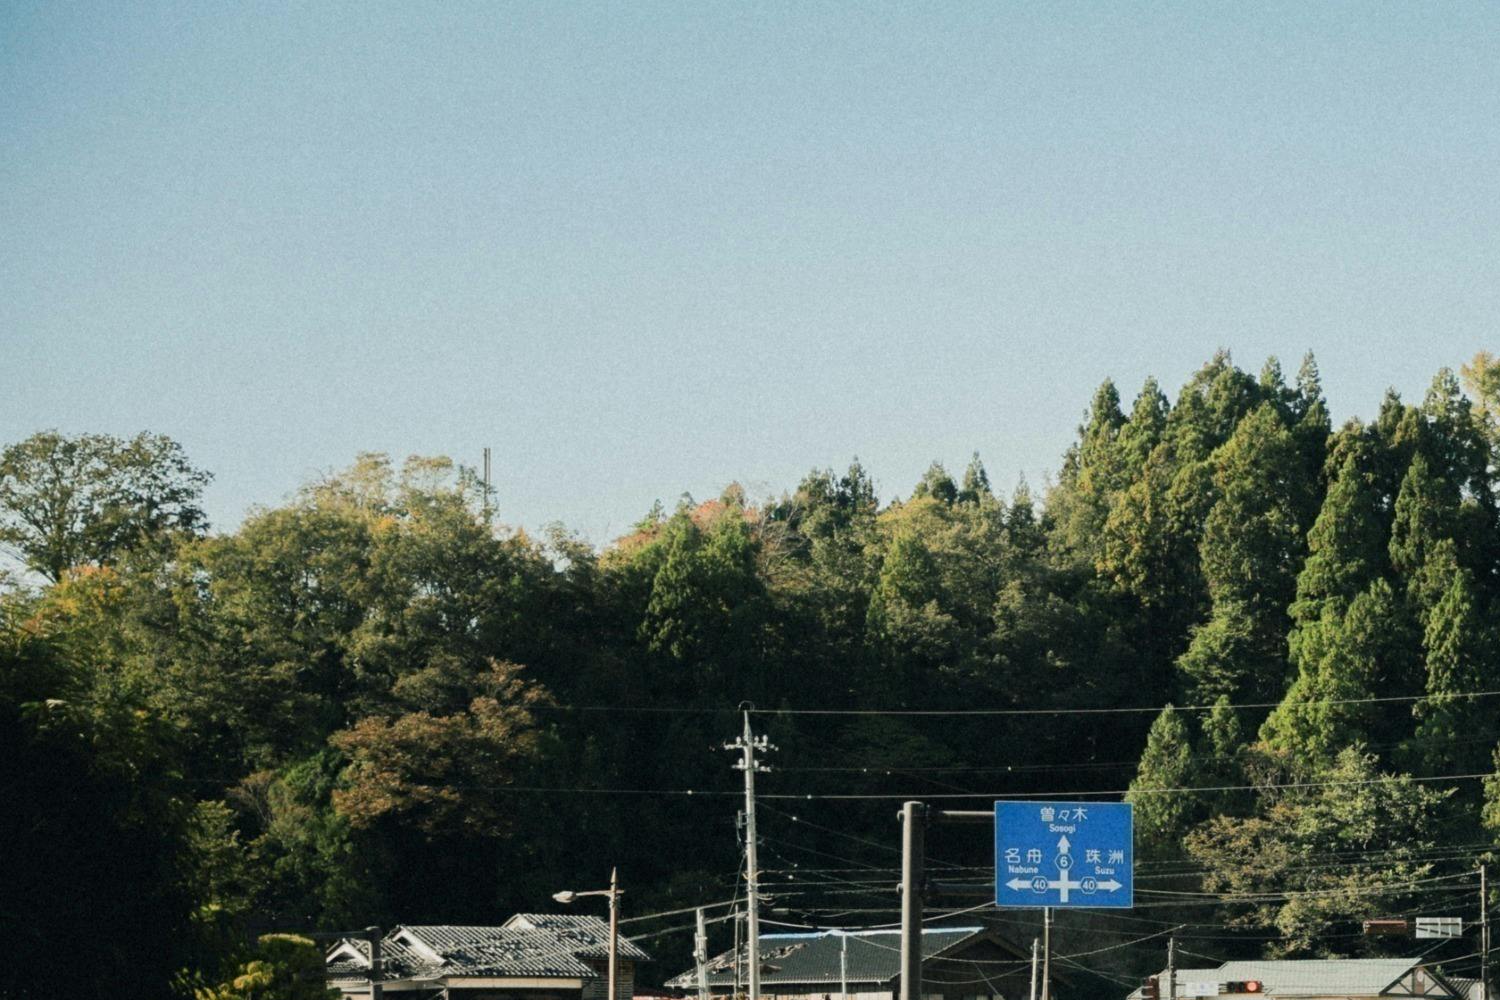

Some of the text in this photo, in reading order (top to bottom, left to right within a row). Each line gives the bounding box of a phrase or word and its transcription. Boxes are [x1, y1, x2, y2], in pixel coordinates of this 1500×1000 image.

[1049, 823, 1076, 834] Sosogi
[1004, 847, 1043, 864] 名舟
[1085, 849, 1124, 865] 珠洲
[1060, 857, 1068, 867] 6
[1008, 865, 1039, 874] Nabune
[1095, 866, 1115, 875] Suzu
[1033, 881, 1046, 890] 40
[1082, 881, 1095, 890] 40
